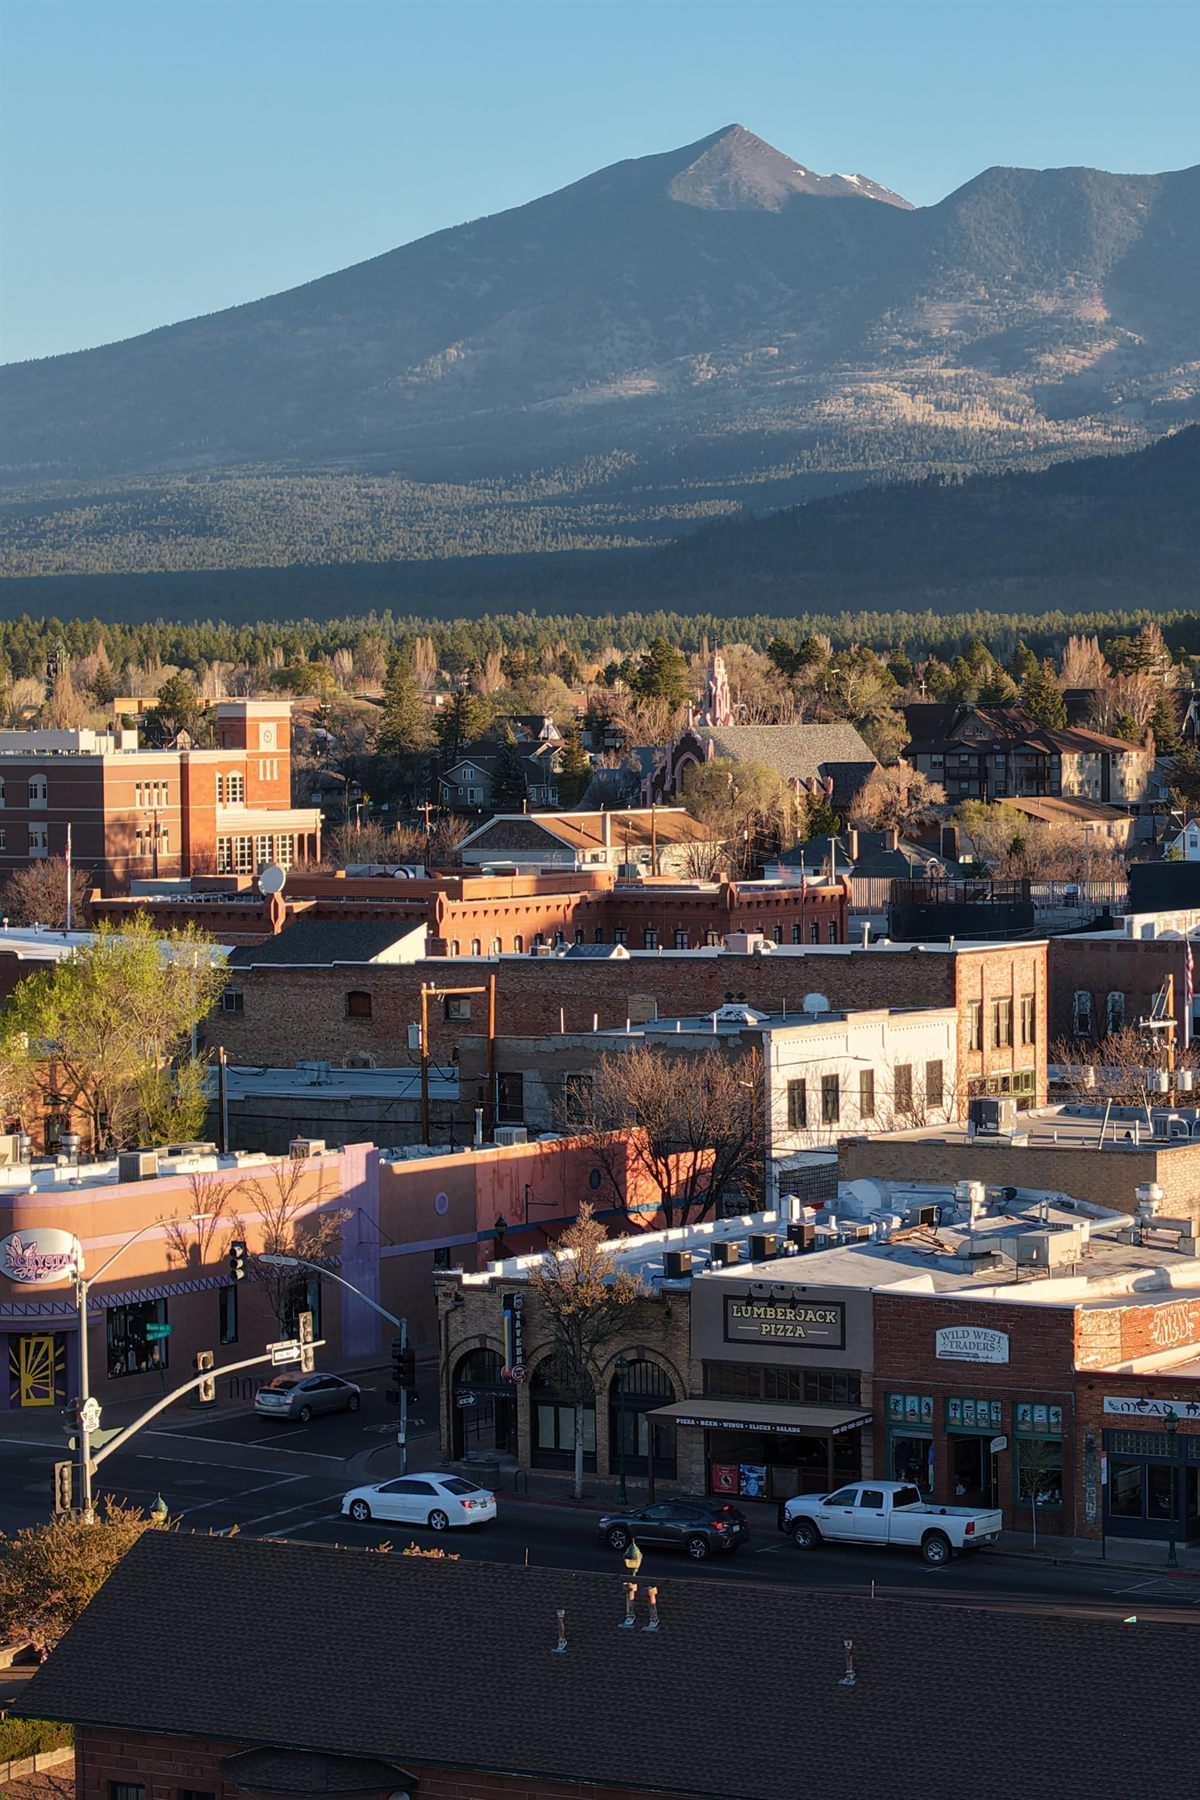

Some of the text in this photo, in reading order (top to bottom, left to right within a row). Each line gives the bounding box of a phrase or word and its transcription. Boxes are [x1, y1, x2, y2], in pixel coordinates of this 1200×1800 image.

[732, 1305, 837, 1324] LUMBERJACK
[514, 1311, 523, 1364] TAVERN
[760, 1323, 806, 1338] PIZZA
[940, 1329, 1003, 1344] WILD WEST
[948, 1340, 996, 1352] TRADERS
[749, 1423, 771, 1431] SLICES
